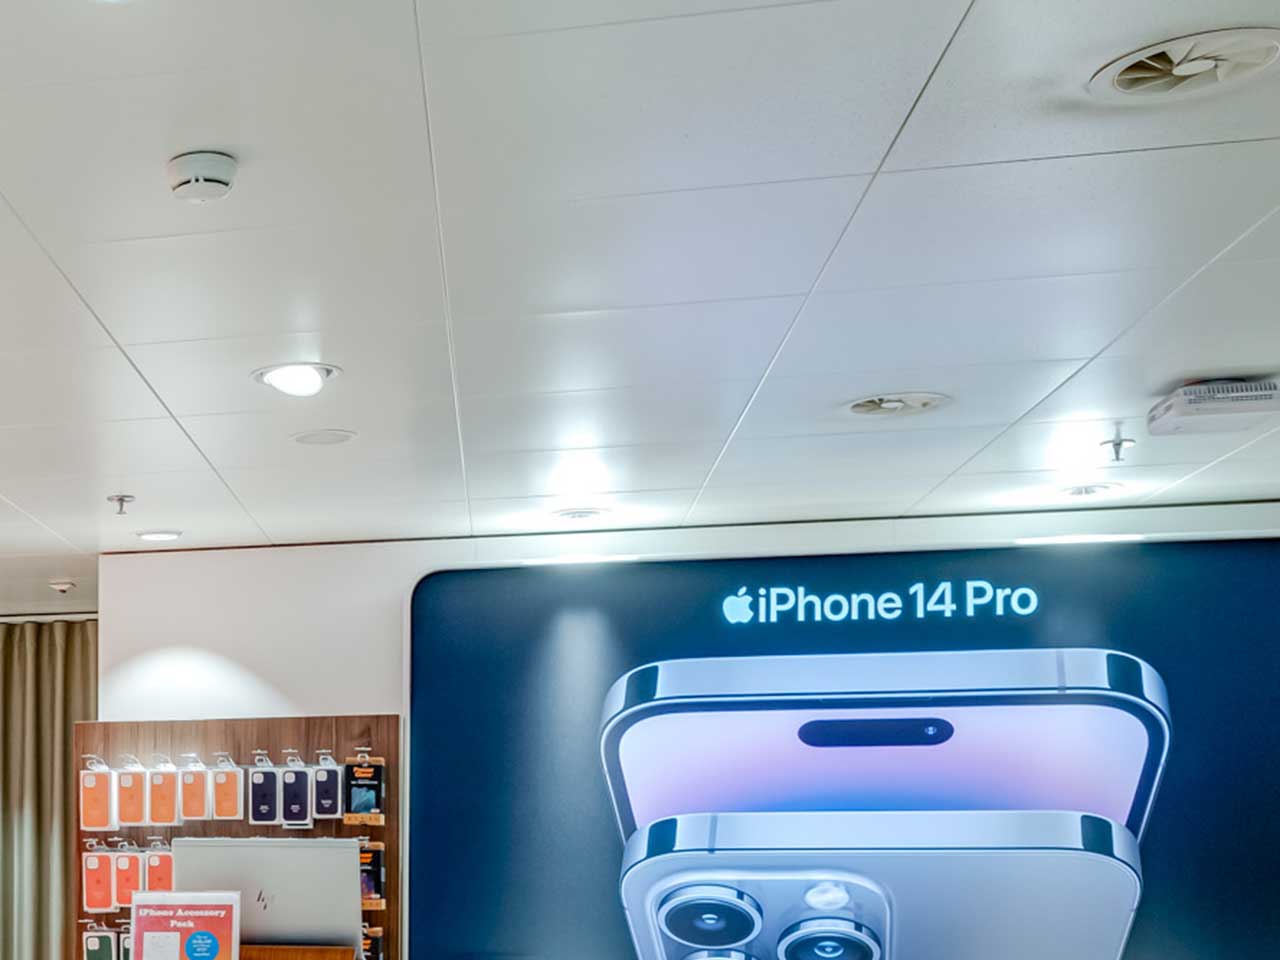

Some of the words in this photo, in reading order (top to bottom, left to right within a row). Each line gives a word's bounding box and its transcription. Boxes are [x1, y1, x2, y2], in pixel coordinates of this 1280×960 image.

[758, 586, 903, 623] iPhone
[908, 580, 957, 619] 14
[965, 579, 1039, 617] Pro
[175, 908, 226, 918] Accessory
[169, 919, 195, 928] Pack
